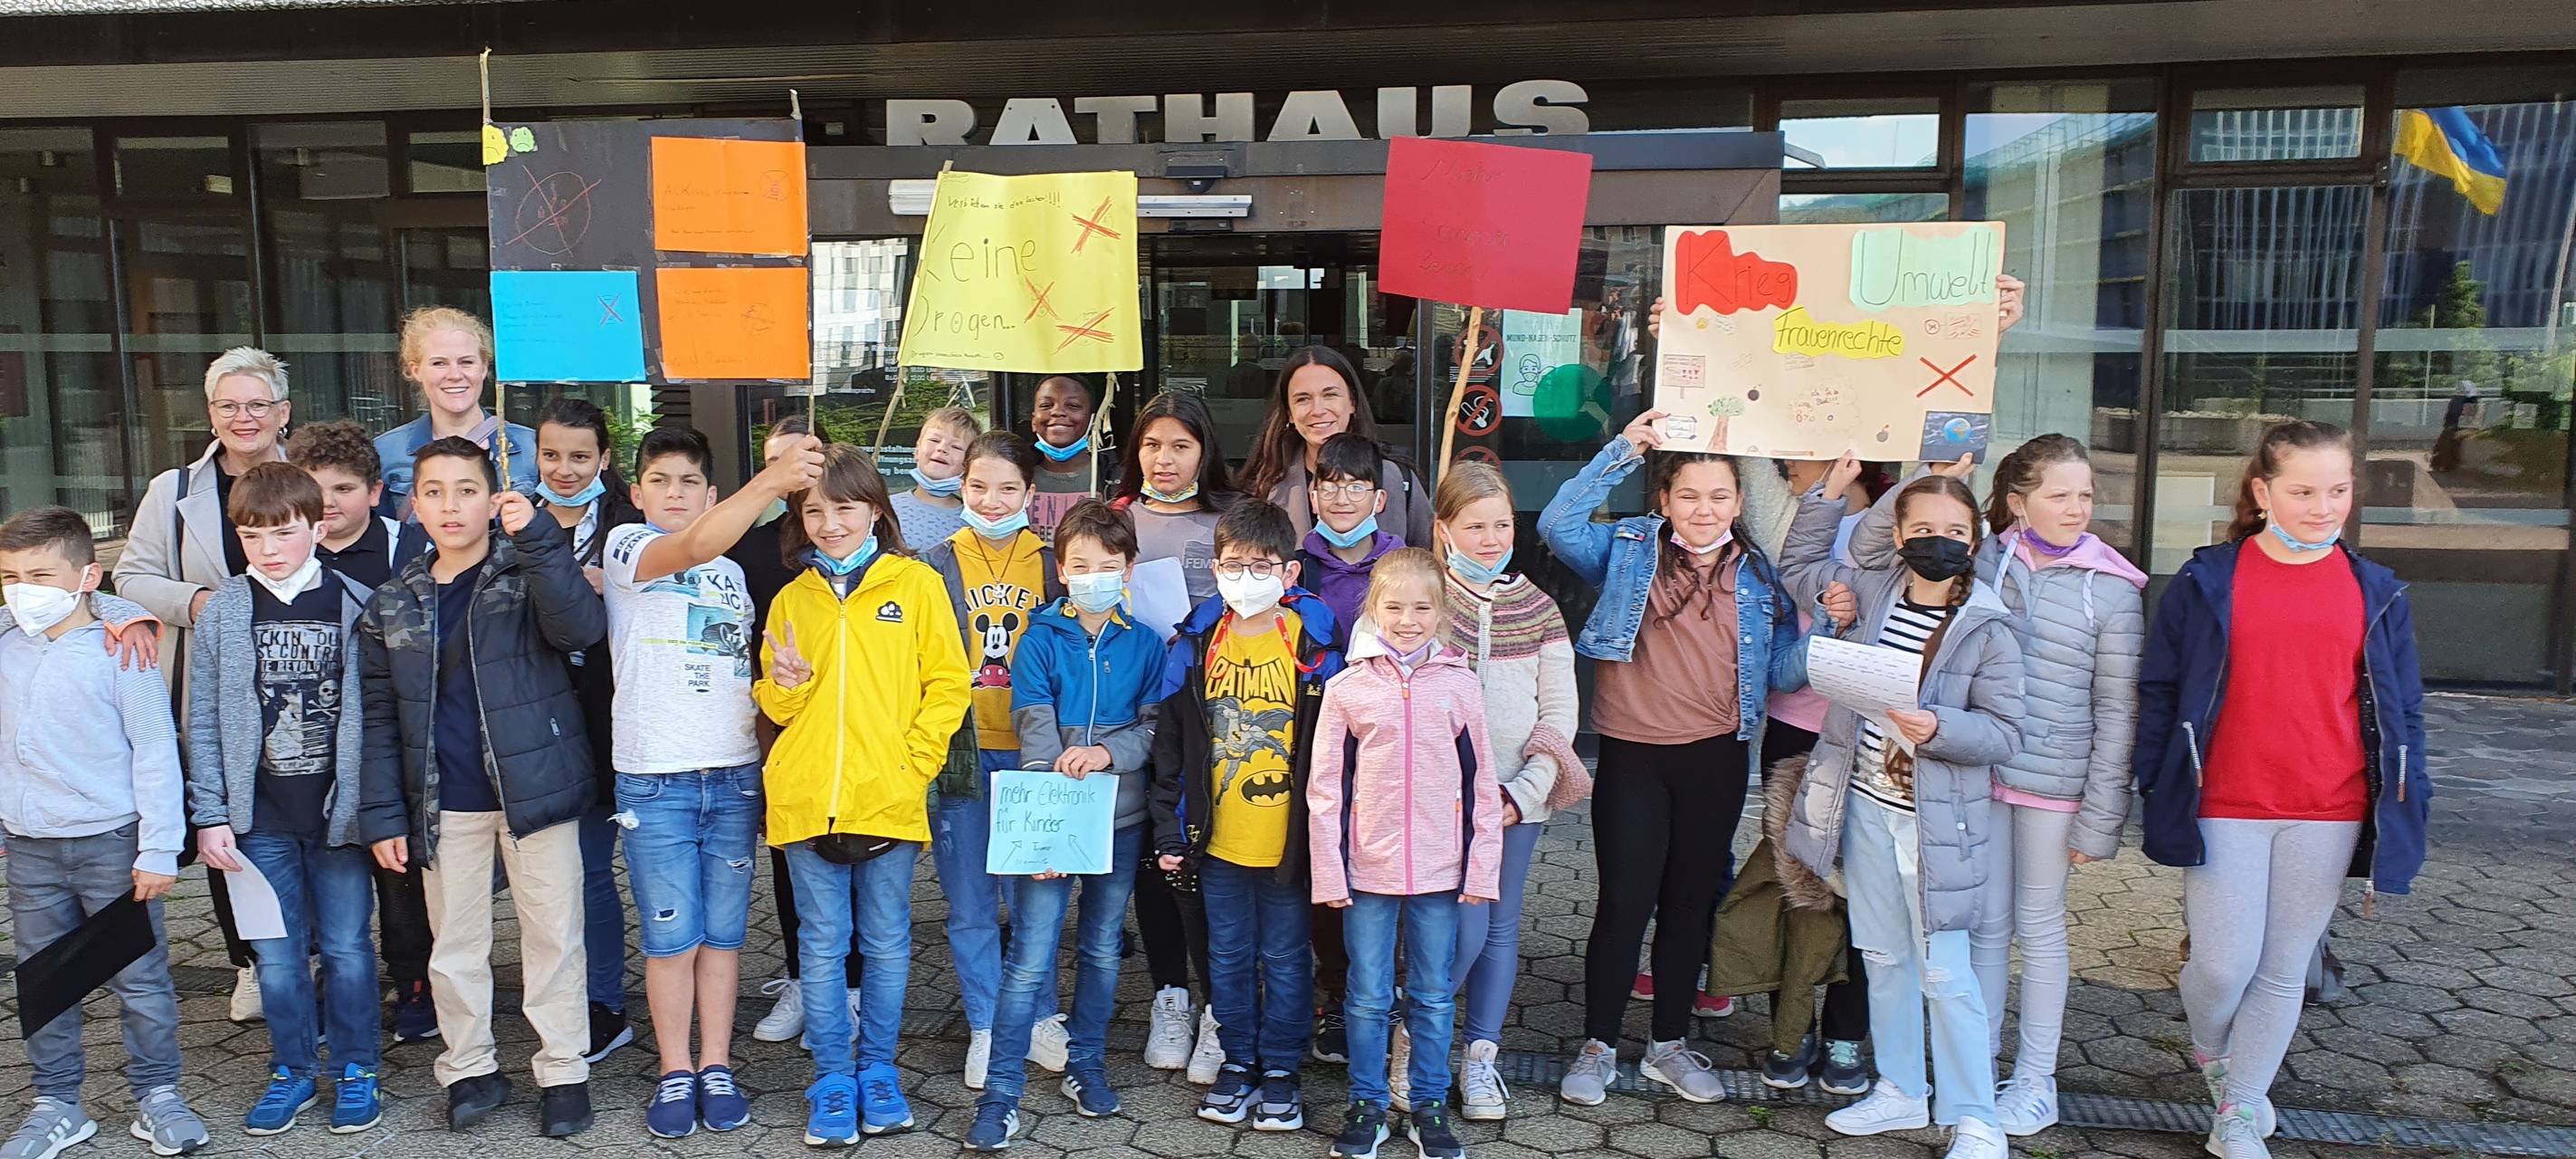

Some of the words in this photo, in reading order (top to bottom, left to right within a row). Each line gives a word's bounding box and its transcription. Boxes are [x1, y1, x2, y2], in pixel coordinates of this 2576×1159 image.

[886, 80, 1590, 147] RATHAUS
[1685, 235, 1794, 304] Krieg
[1859, 229, 1991, 305] Umwelt
[1777, 306, 1902, 356] Frauenrechte
[684, 663, 711, 672] SKATE
[688, 679, 711, 687] PARK
[694, 672, 711, 680] THE
[1205, 656, 1293, 706] BATMAN
